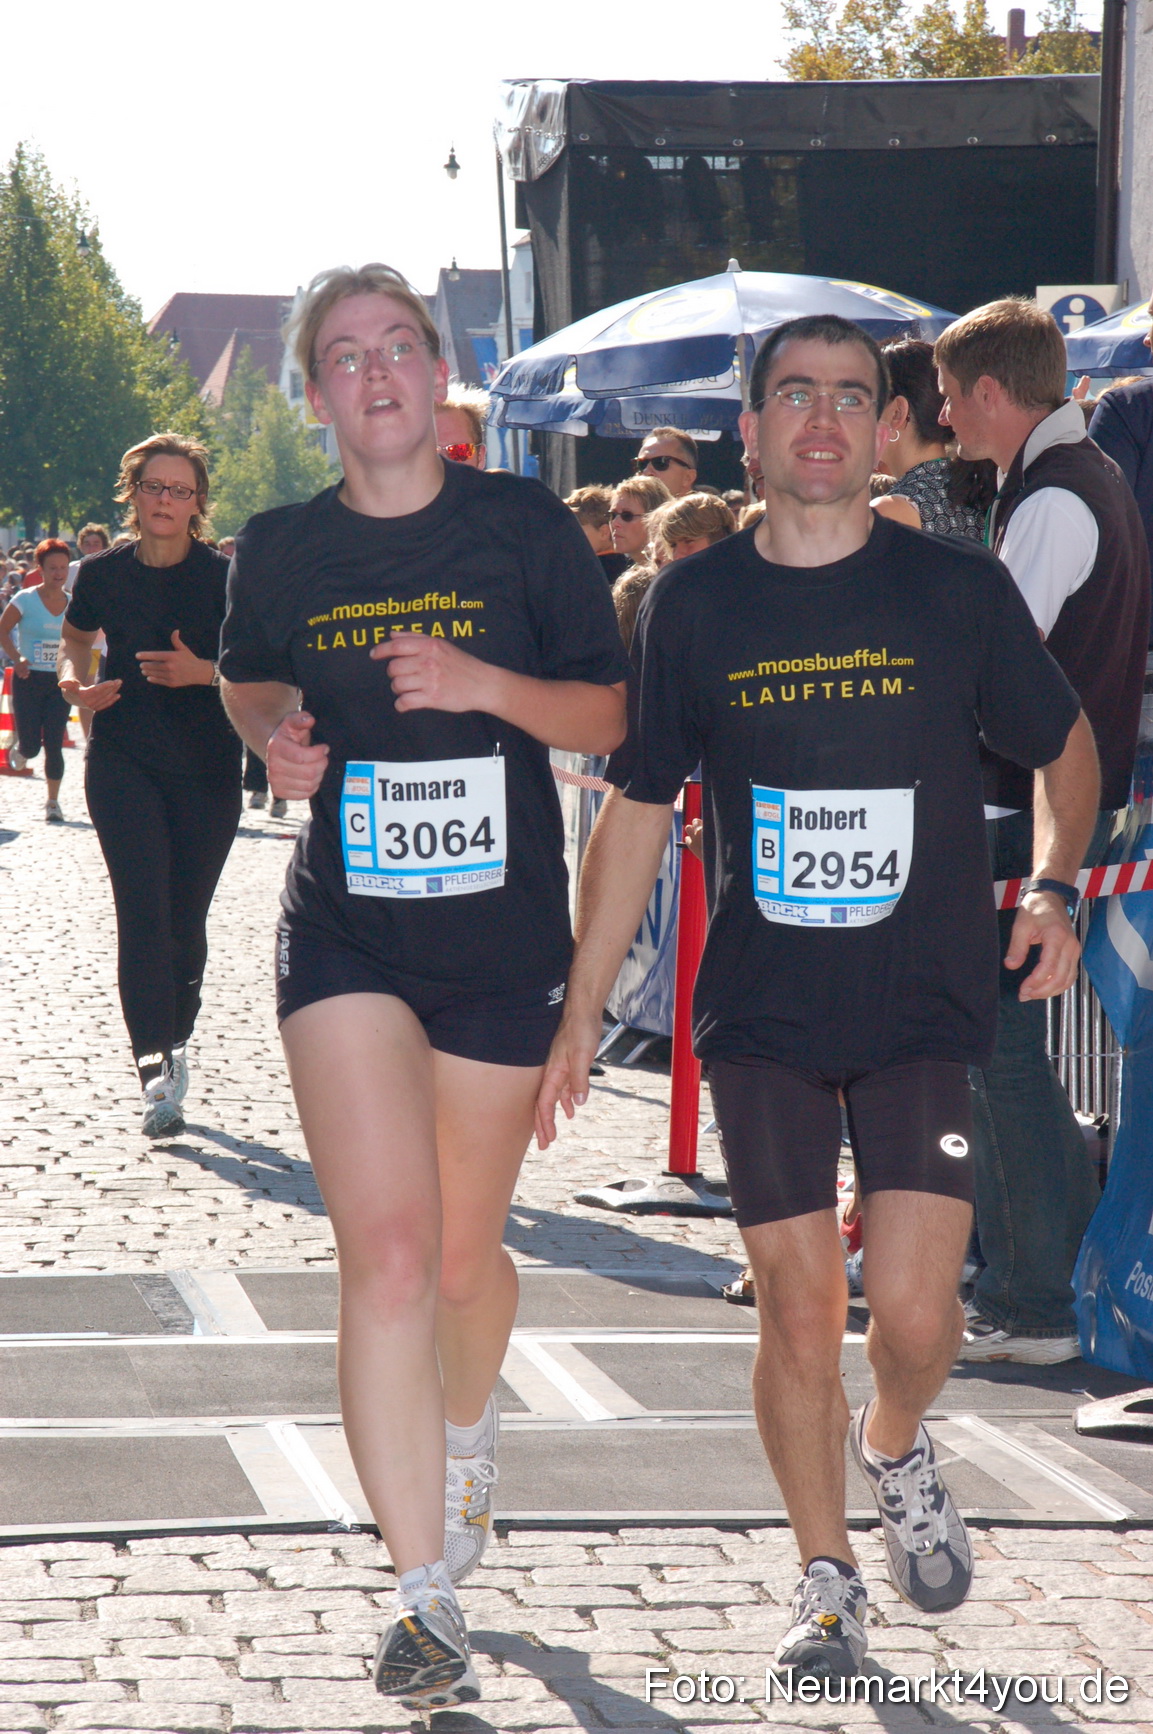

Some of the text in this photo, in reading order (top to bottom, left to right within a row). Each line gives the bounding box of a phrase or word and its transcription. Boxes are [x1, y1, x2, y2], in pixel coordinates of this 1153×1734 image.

[307, 591, 484, 626] www.moosbueffel.com
[728, 648, 914, 681] www.moosbueffel.com
[377, 778, 467, 802] Tamara
[350, 813, 366, 833] C
[788, 805, 867, 831] Robert
[384, 815, 496, 861] 3064
[761, 838, 776, 859] B
[790, 849, 900, 890] 2954
[349, 875, 405, 891] BOCK
[757, 900, 809, 918] BOCK
